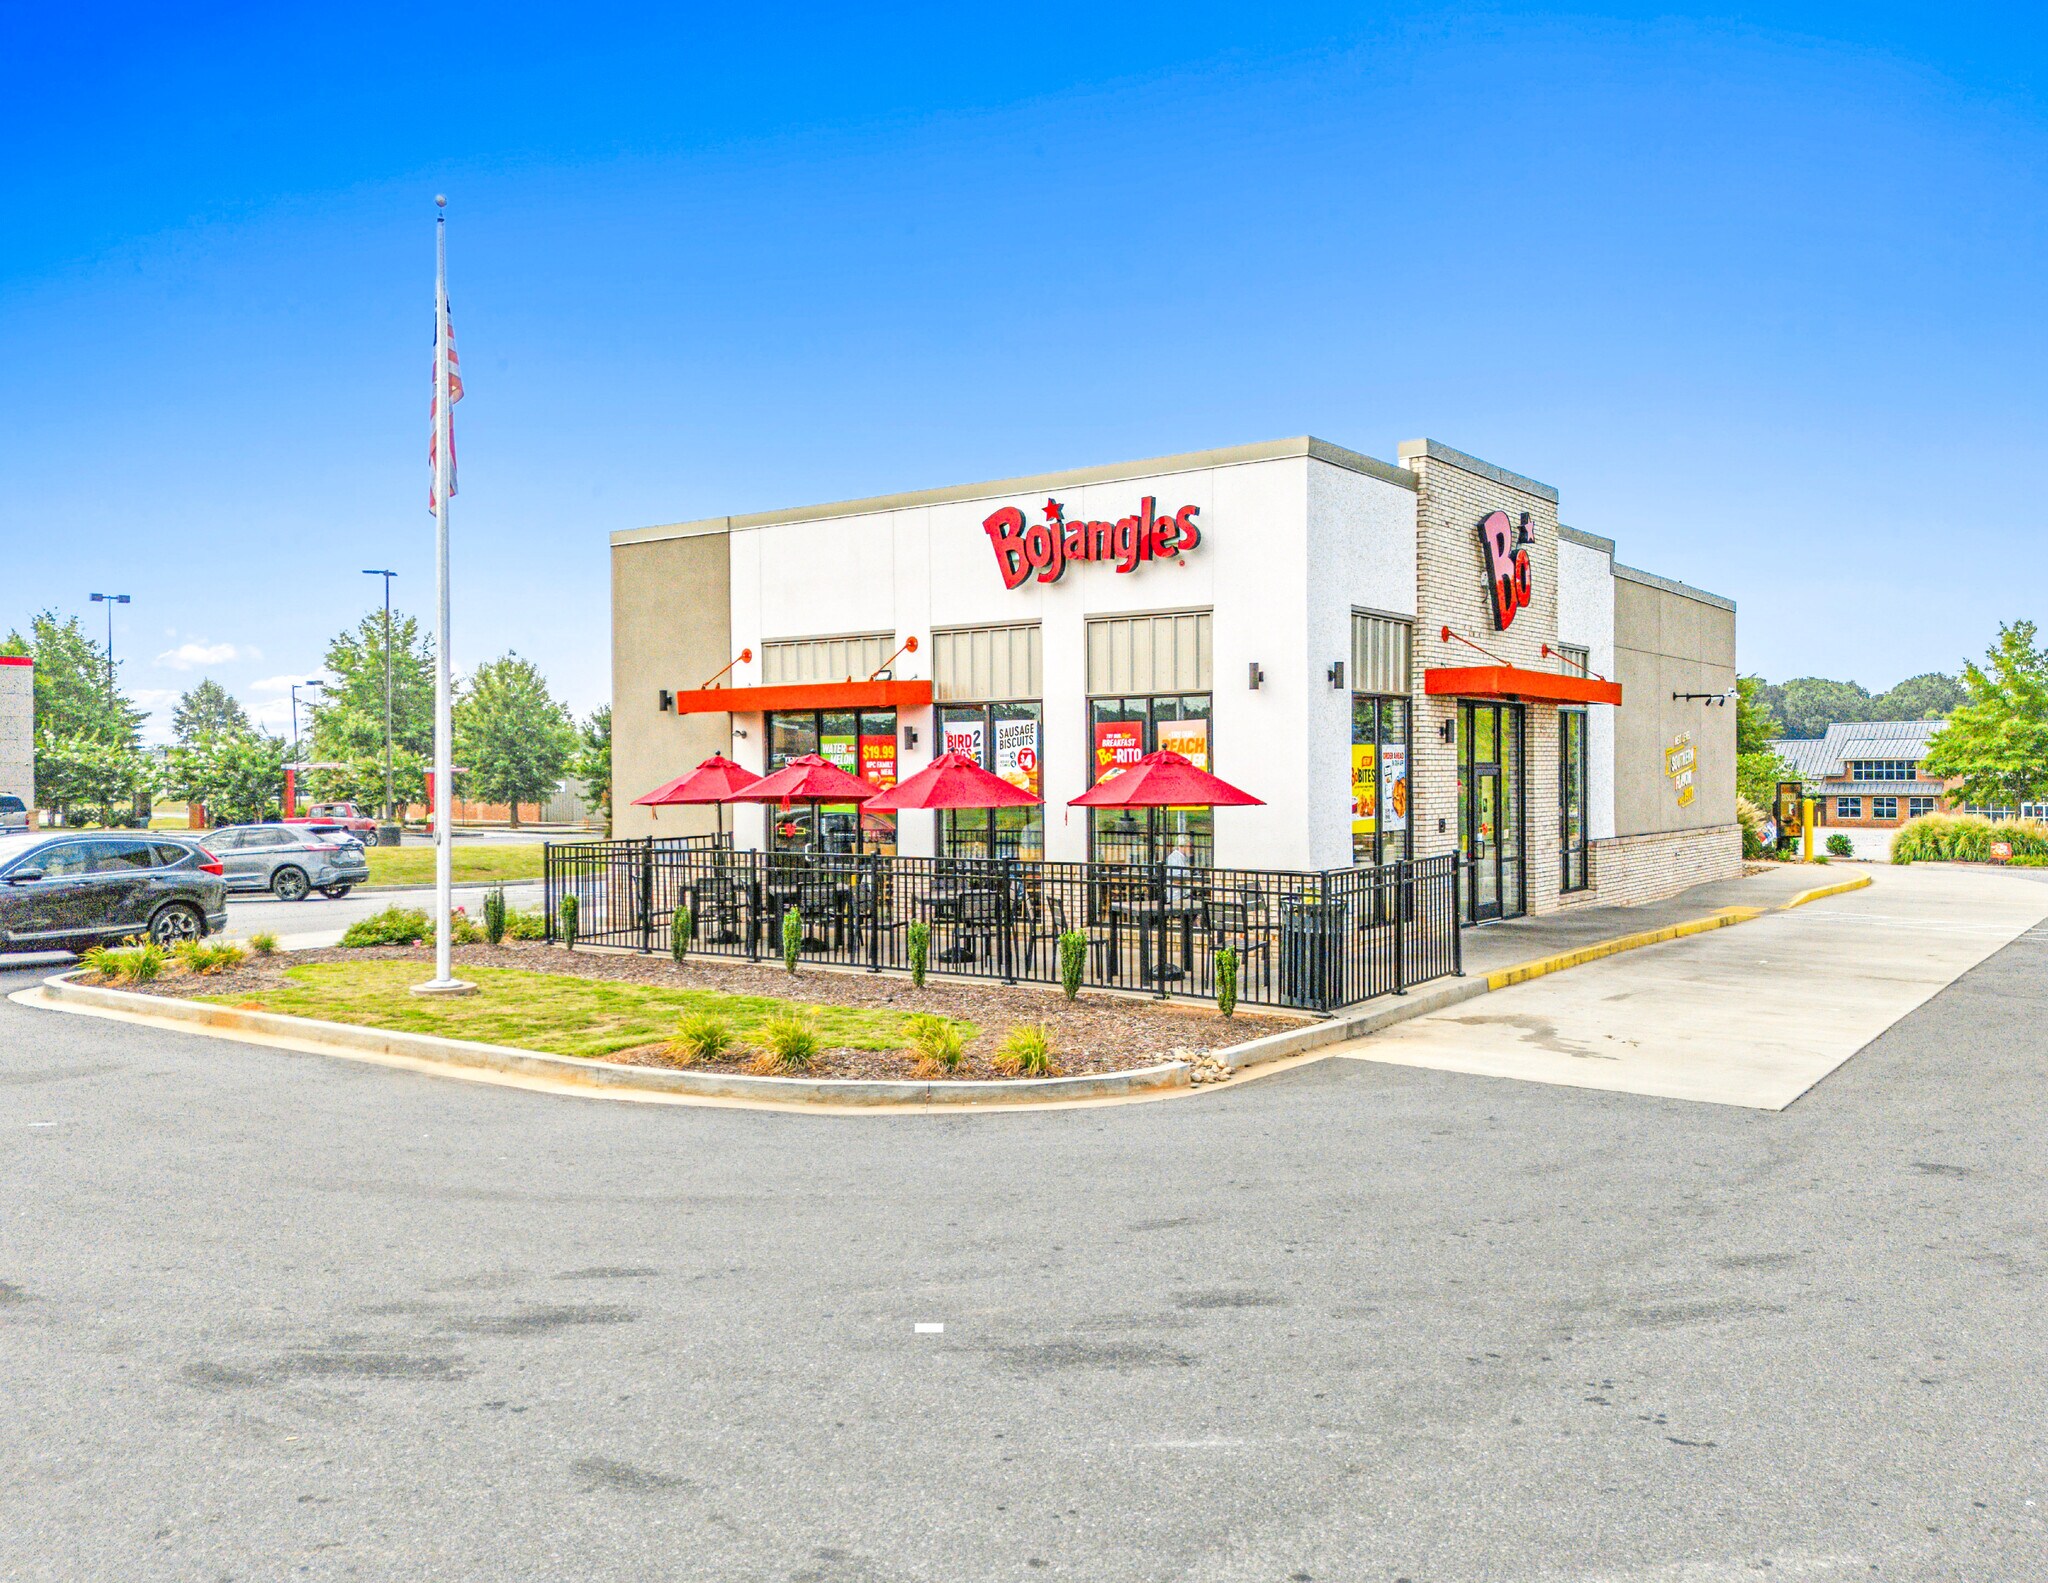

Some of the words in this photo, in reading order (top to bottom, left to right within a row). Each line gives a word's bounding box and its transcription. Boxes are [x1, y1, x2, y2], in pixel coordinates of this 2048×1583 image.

[982, 496, 1201, 590] Bojangles
[999, 723, 1034, 739] SAUSAGE
[947, 734, 972, 748] BIRD
[973, 730, 981, 748] 2
[999, 735, 1034, 750] BISCUITS
[1102, 738, 1136, 747] BREAKFAST
[822, 743, 847, 754] WATER
[862, 744, 895, 760] $19.99
[831, 754, 855, 765] MELON
